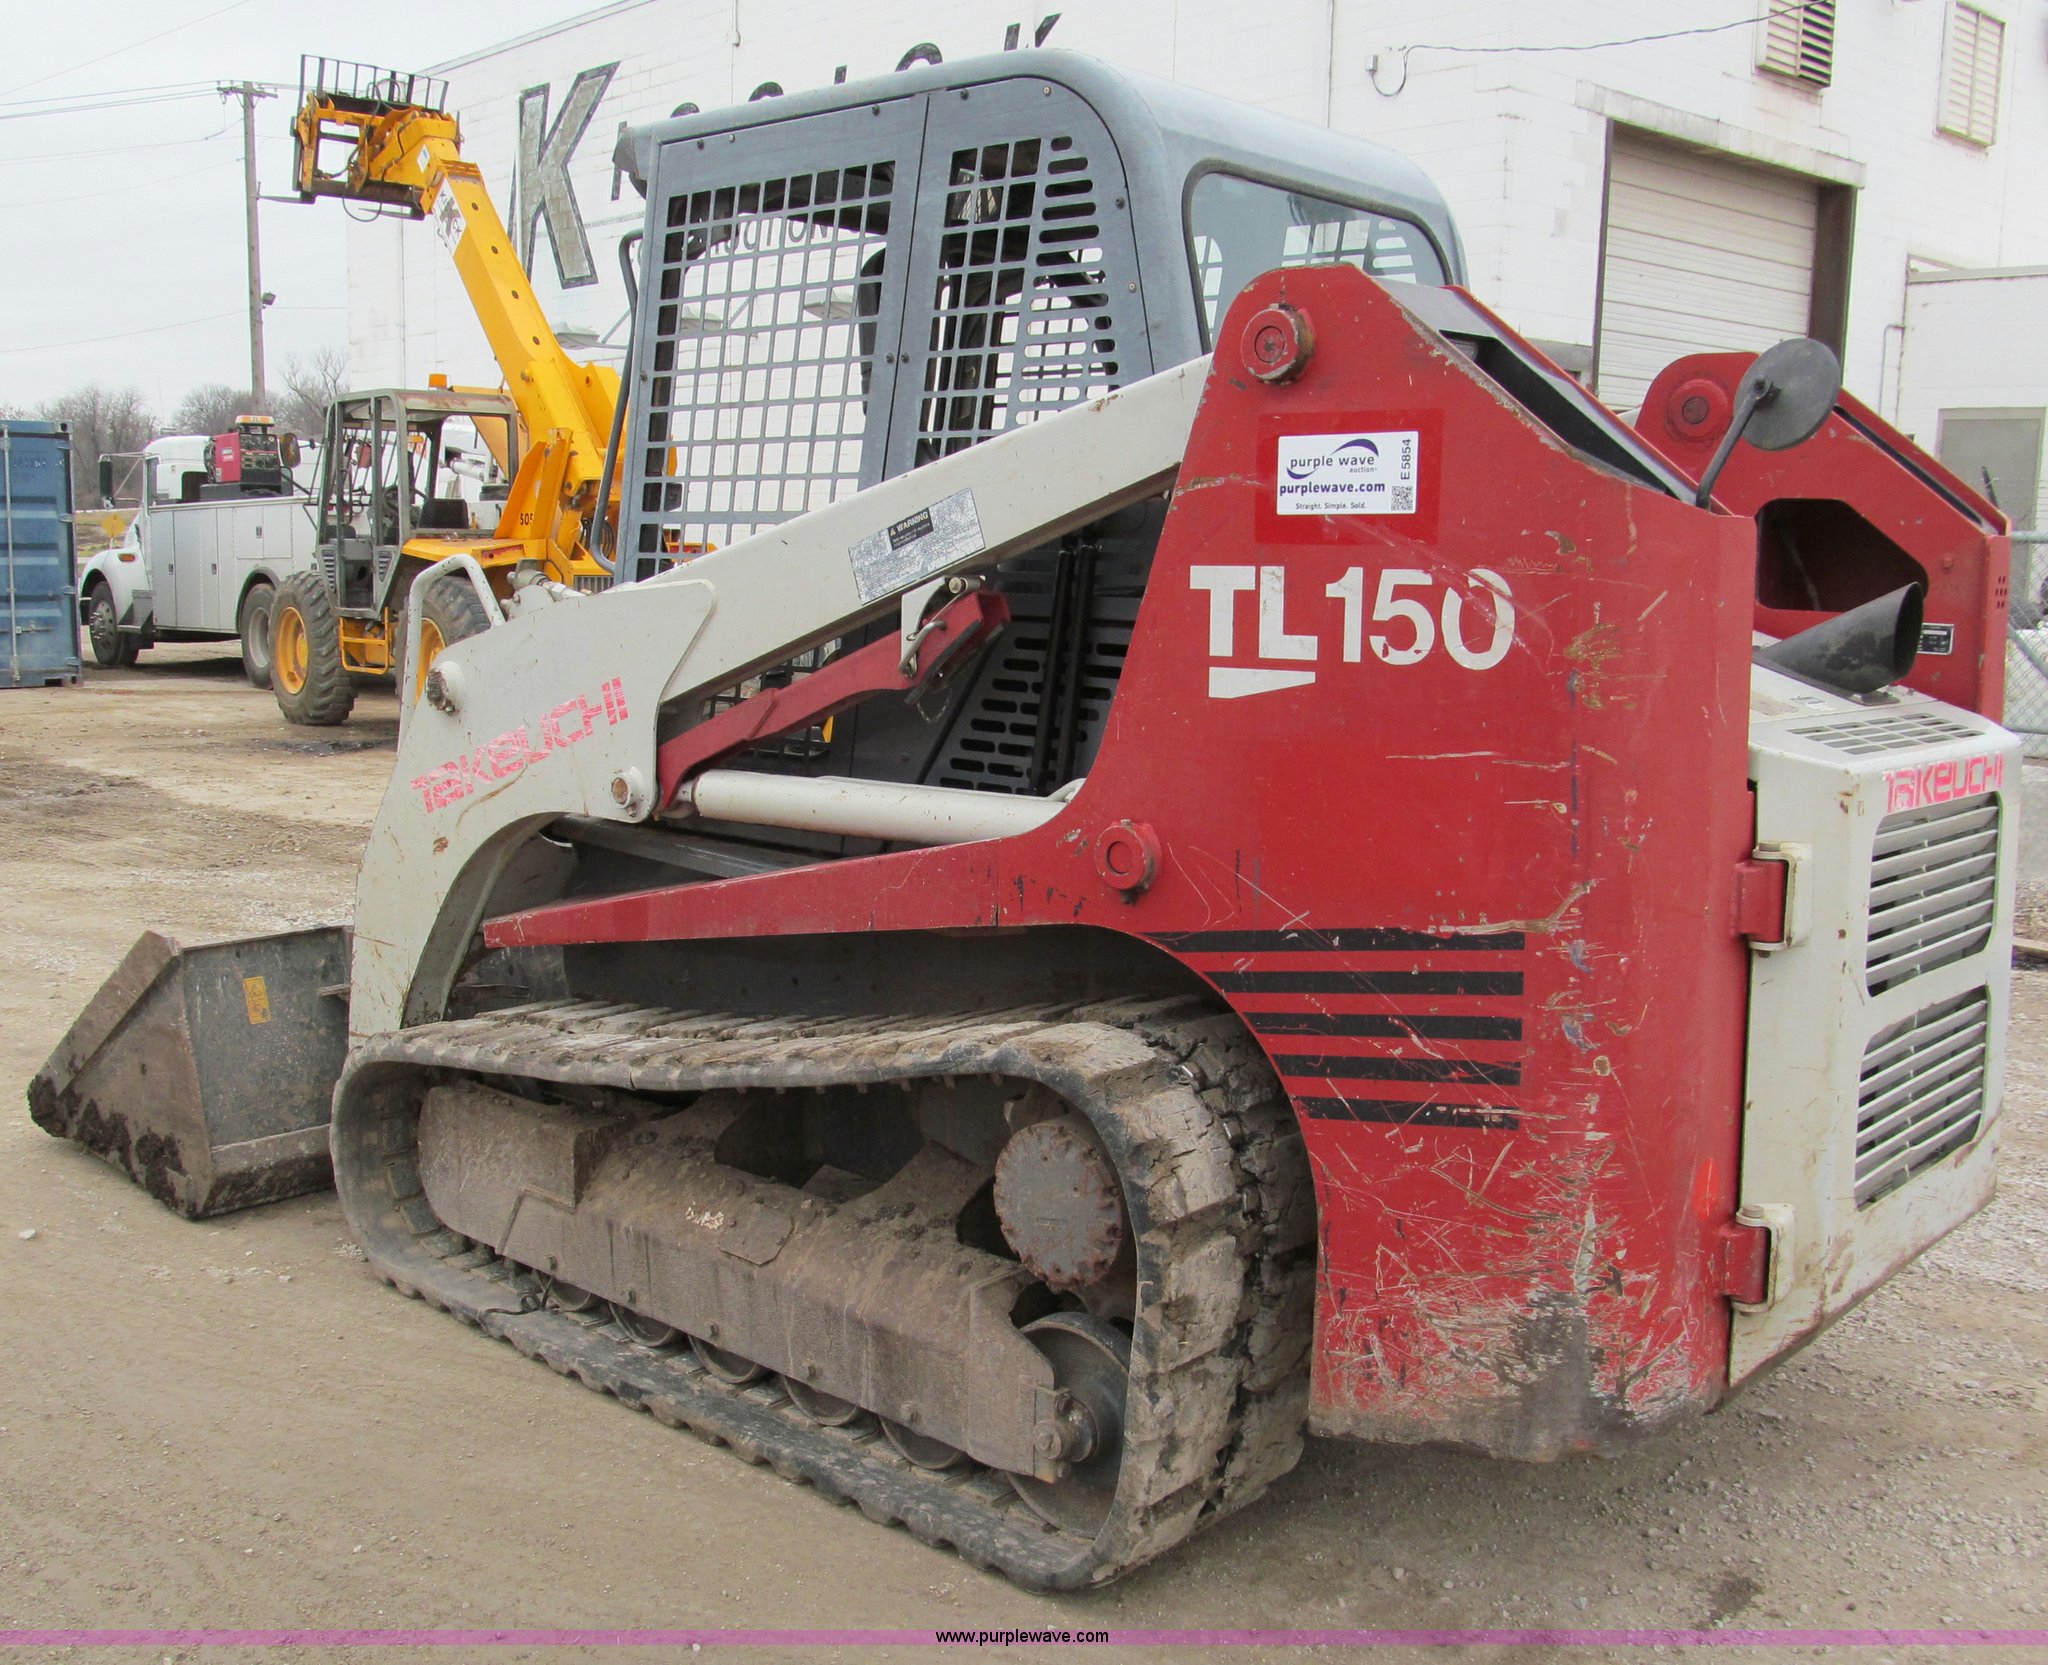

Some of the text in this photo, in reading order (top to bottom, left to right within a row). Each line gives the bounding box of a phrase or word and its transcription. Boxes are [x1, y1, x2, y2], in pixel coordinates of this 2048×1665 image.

[1290, 455, 1375, 470] purple wave
[1279, 481, 1386, 497] purplewave.com
[1350, 501, 1367, 509] Sold.
[896, 511, 929, 532] WARNING
